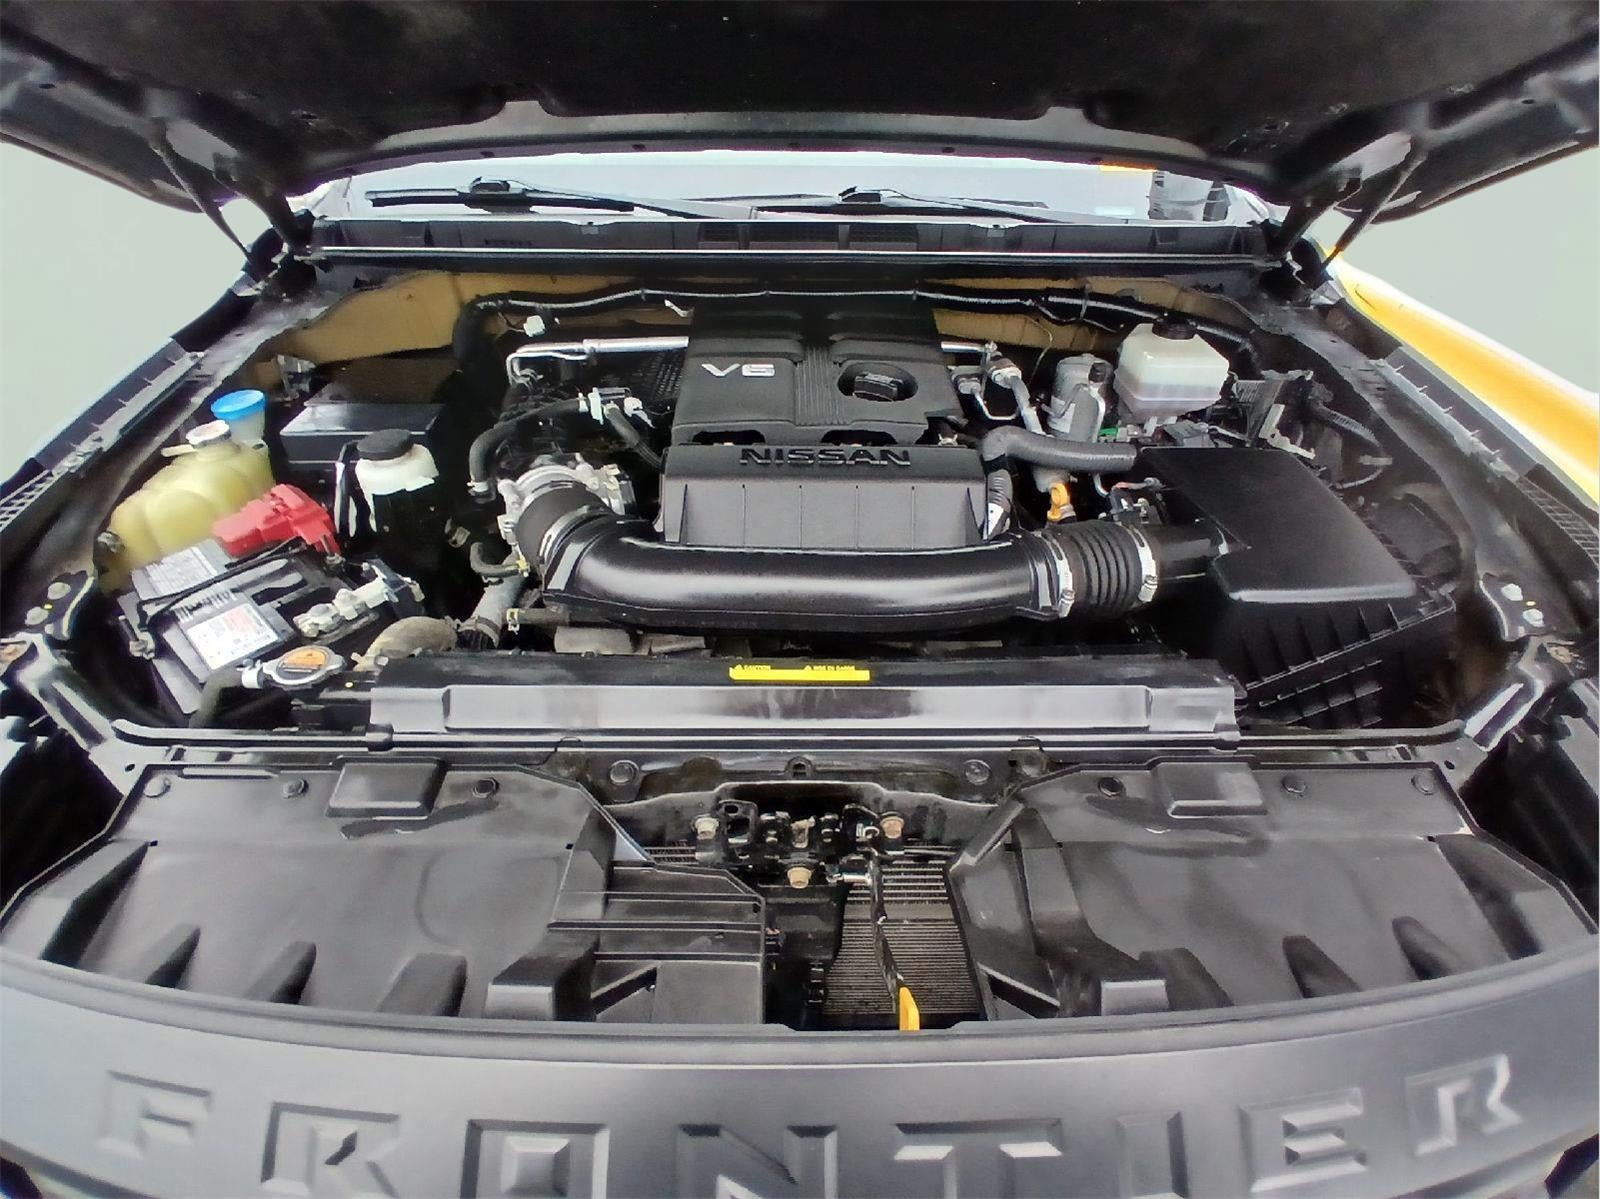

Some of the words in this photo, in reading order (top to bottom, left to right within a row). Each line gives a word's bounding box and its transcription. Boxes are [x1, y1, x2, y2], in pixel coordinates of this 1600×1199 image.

[701, 362, 776, 377] V6
[739, 448, 911, 467] NISSAN
[97, 1053, 1523, 1199] FRONTIER
